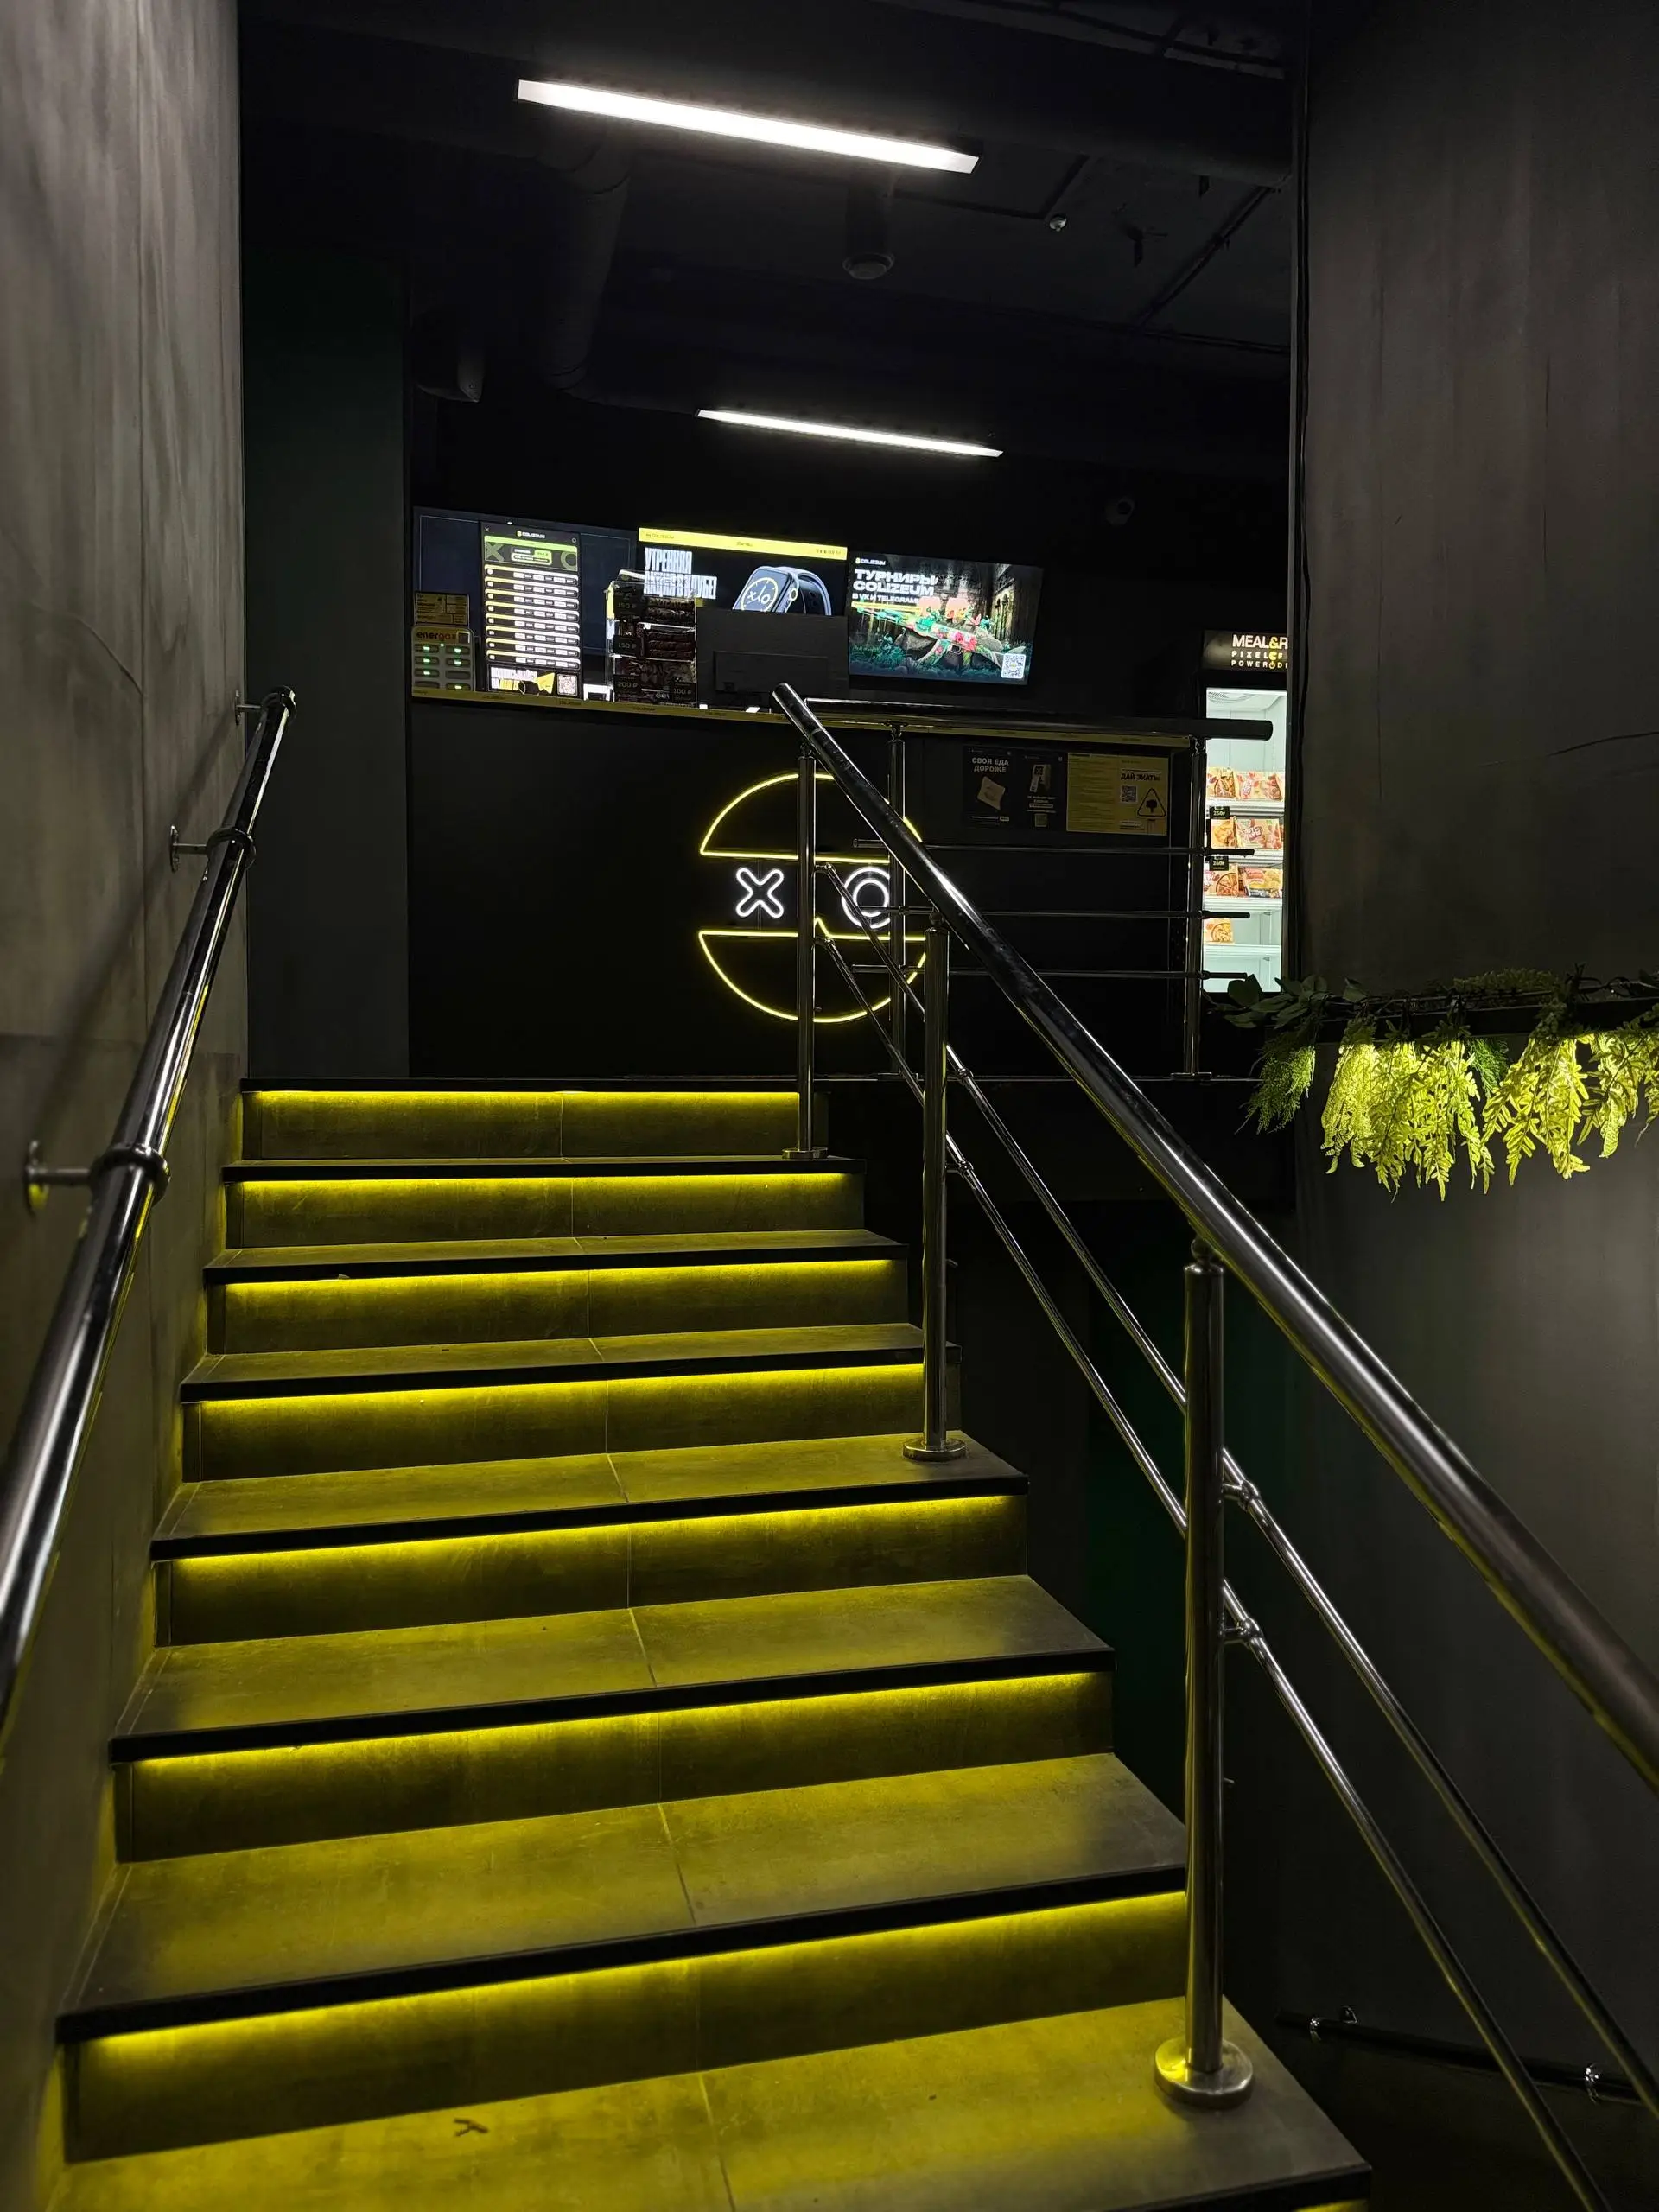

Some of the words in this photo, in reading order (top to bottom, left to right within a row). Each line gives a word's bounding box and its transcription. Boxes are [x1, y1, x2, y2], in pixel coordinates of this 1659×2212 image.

[854, 569, 938, 586] ТУРНИРЫ
[853, 580, 934, 596] COLIZEUM
[971, 757, 993, 766] СВОЯ
[973, 765, 1007, 773] ДОРОЖЕ
